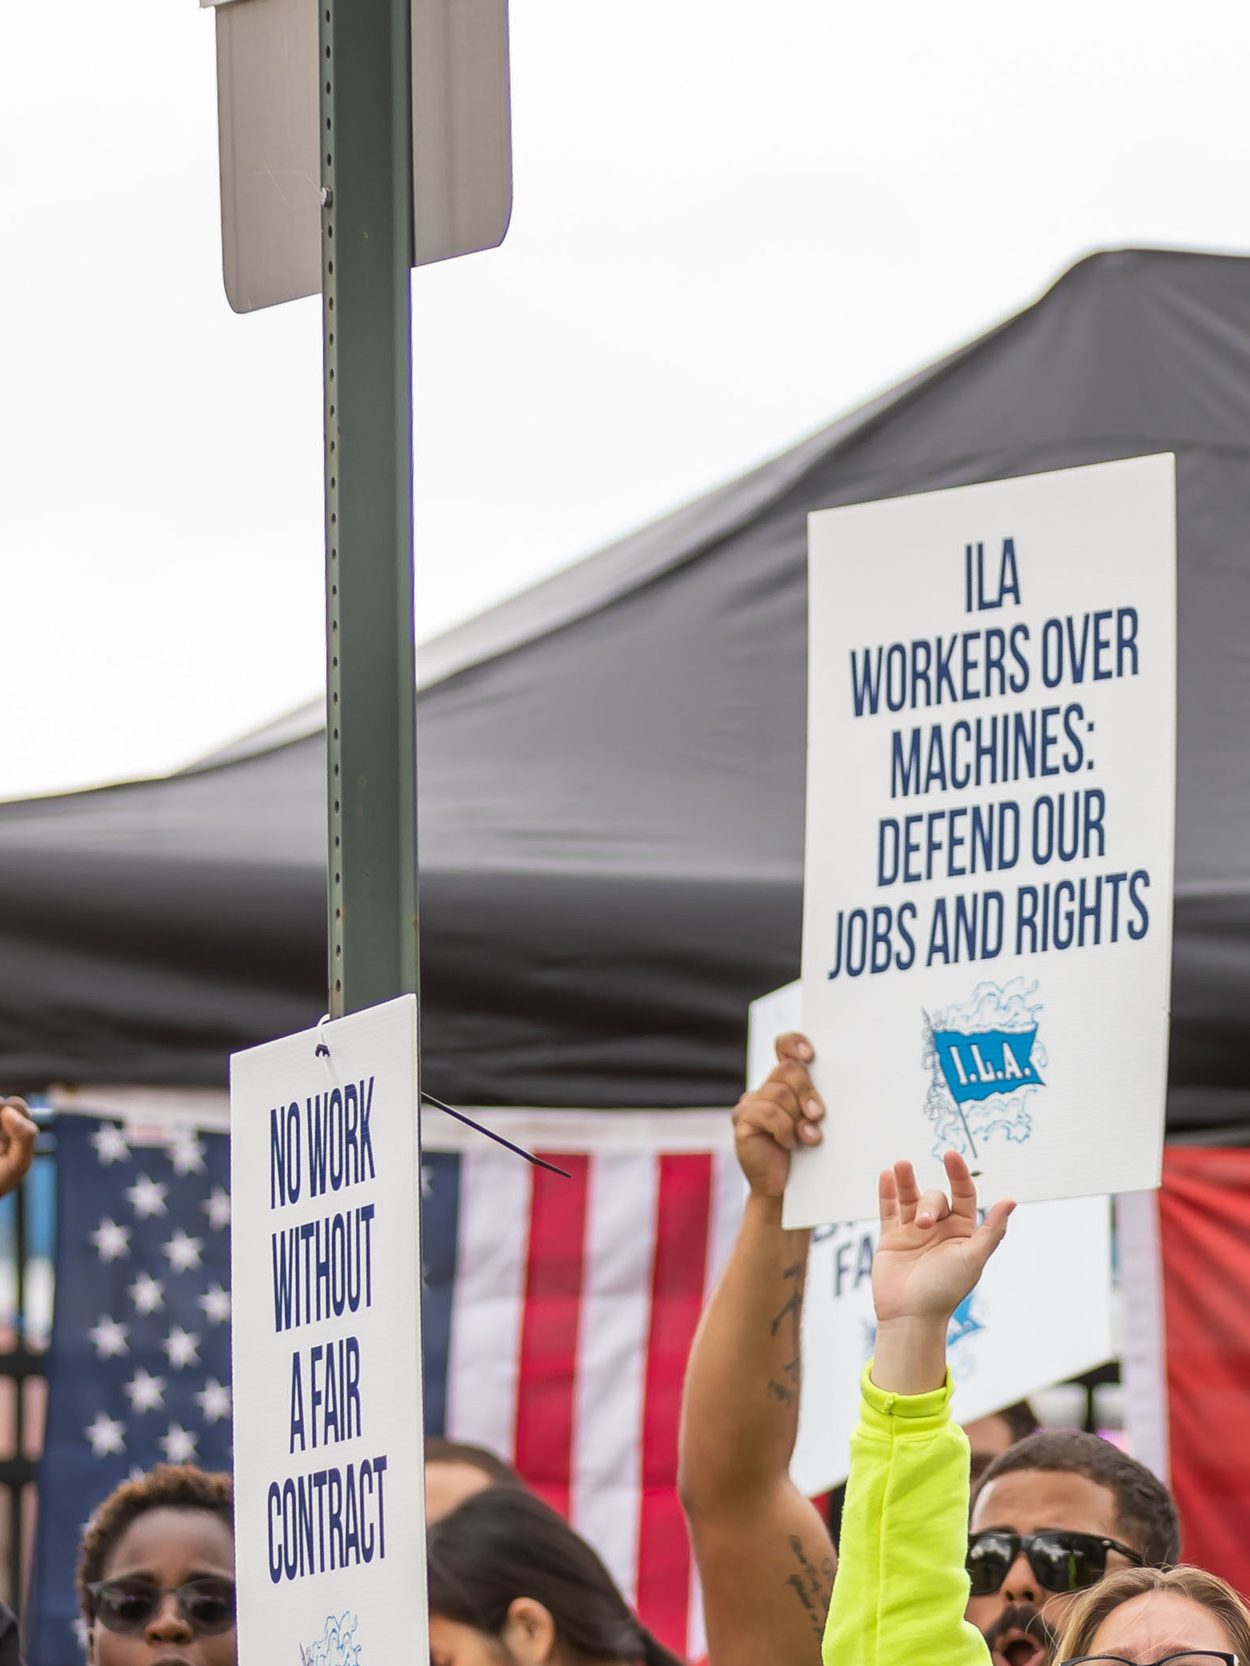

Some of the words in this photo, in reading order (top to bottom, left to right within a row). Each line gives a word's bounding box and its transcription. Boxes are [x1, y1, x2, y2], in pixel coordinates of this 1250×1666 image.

[965, 536, 1022, 615] ILA
[851, 623, 1030, 717] WORKERS
[1042, 607, 1138, 689] OVER
[891, 703, 1094, 798] MACHINES:
[878, 801, 1020, 887] DEFEND
[1032, 788, 1106, 866] OUR
[828, 902, 917, 980] JOBS
[926, 890, 1004, 967] AND
[1015, 869, 1150, 956] RIGHTS
[948, 1040, 1032, 1086] I.L.A.
[270, 1102, 301, 1210] NO
[306, 1076, 376, 1198] WORK
[271, 1203, 375, 1333] WITHOUT
[289, 1351, 306, 1454] A
[310, 1336, 362, 1449] FAIR
[267, 1455, 387, 1584] CONTRACT
